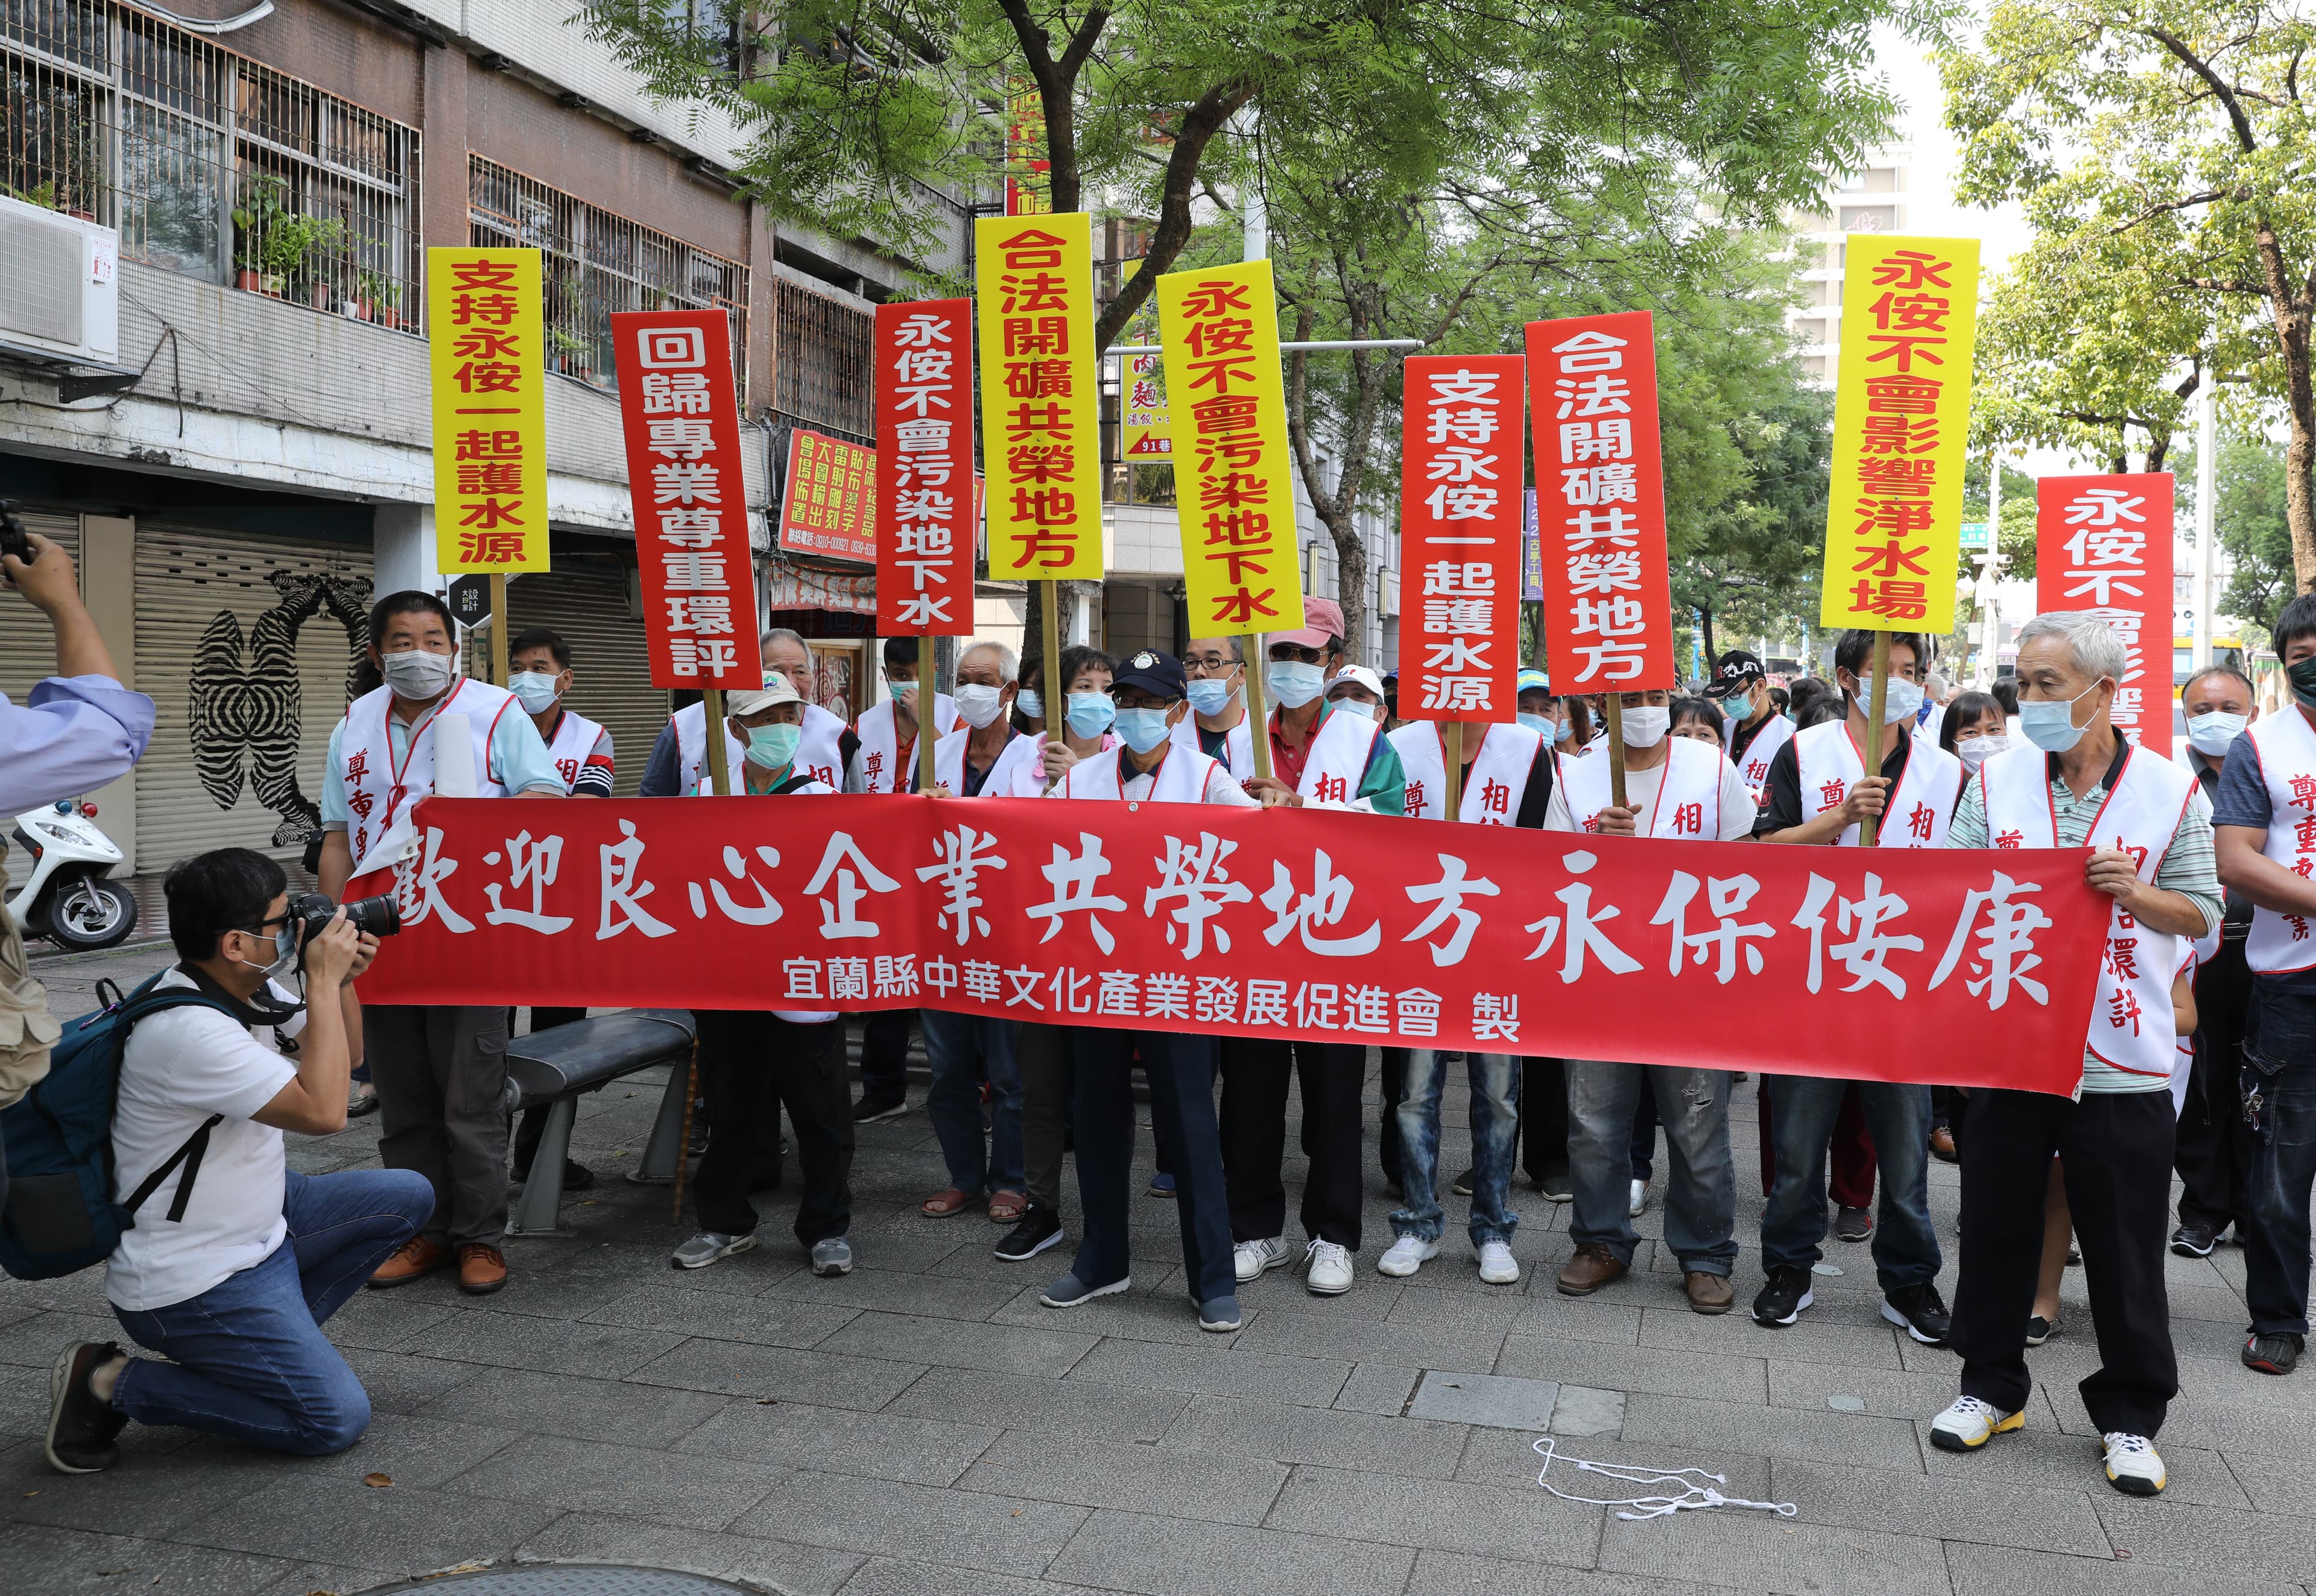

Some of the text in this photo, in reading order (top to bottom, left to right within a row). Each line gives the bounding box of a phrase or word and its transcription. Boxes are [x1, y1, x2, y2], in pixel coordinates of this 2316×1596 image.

[451, 259, 527, 563] 支持永侒一起護水源
[998, 229, 1078, 569] 合法開礦共榮地方
[1127, 413, 1169, 426] 湯餃、
[1848, 250, 1953, 620] 永侒不會影響淨水場
[791, 435, 815, 524] 會場佈置
[808, 441, 832, 528] 大圖輸出
[824, 444, 849, 531] 雷射雕刻
[893, 313, 954, 625] 永侒不會污染地下水
[1142, 439, 1170, 452] 91巷
[1181, 280, 1279, 623] 永侒不會污染地下水
[638, 327, 738, 679] 回歸專業尊重環評
[1421, 369, 1500, 711] 支持永侒一起護水源
[1551, 331, 1647, 683] 合法開礦共榮地方
[469, 589, 479, 612] 設計
[1529, 539, 1540, 587] 古亭工商
[1314, 771, 1346, 804] 相
[1404, 780, 1428, 818] 尊
[1745, 758, 1768, 782] 相
[1672, 802, 1703, 835] 相
[1907, 800, 1935, 841] 相
[391, 818, 2052, 1011] 歡迎良心企業共榮地方永保侒康
[782, 953, 1520, 1043] 宜蘭縣中華文化產業發展促進會 製
